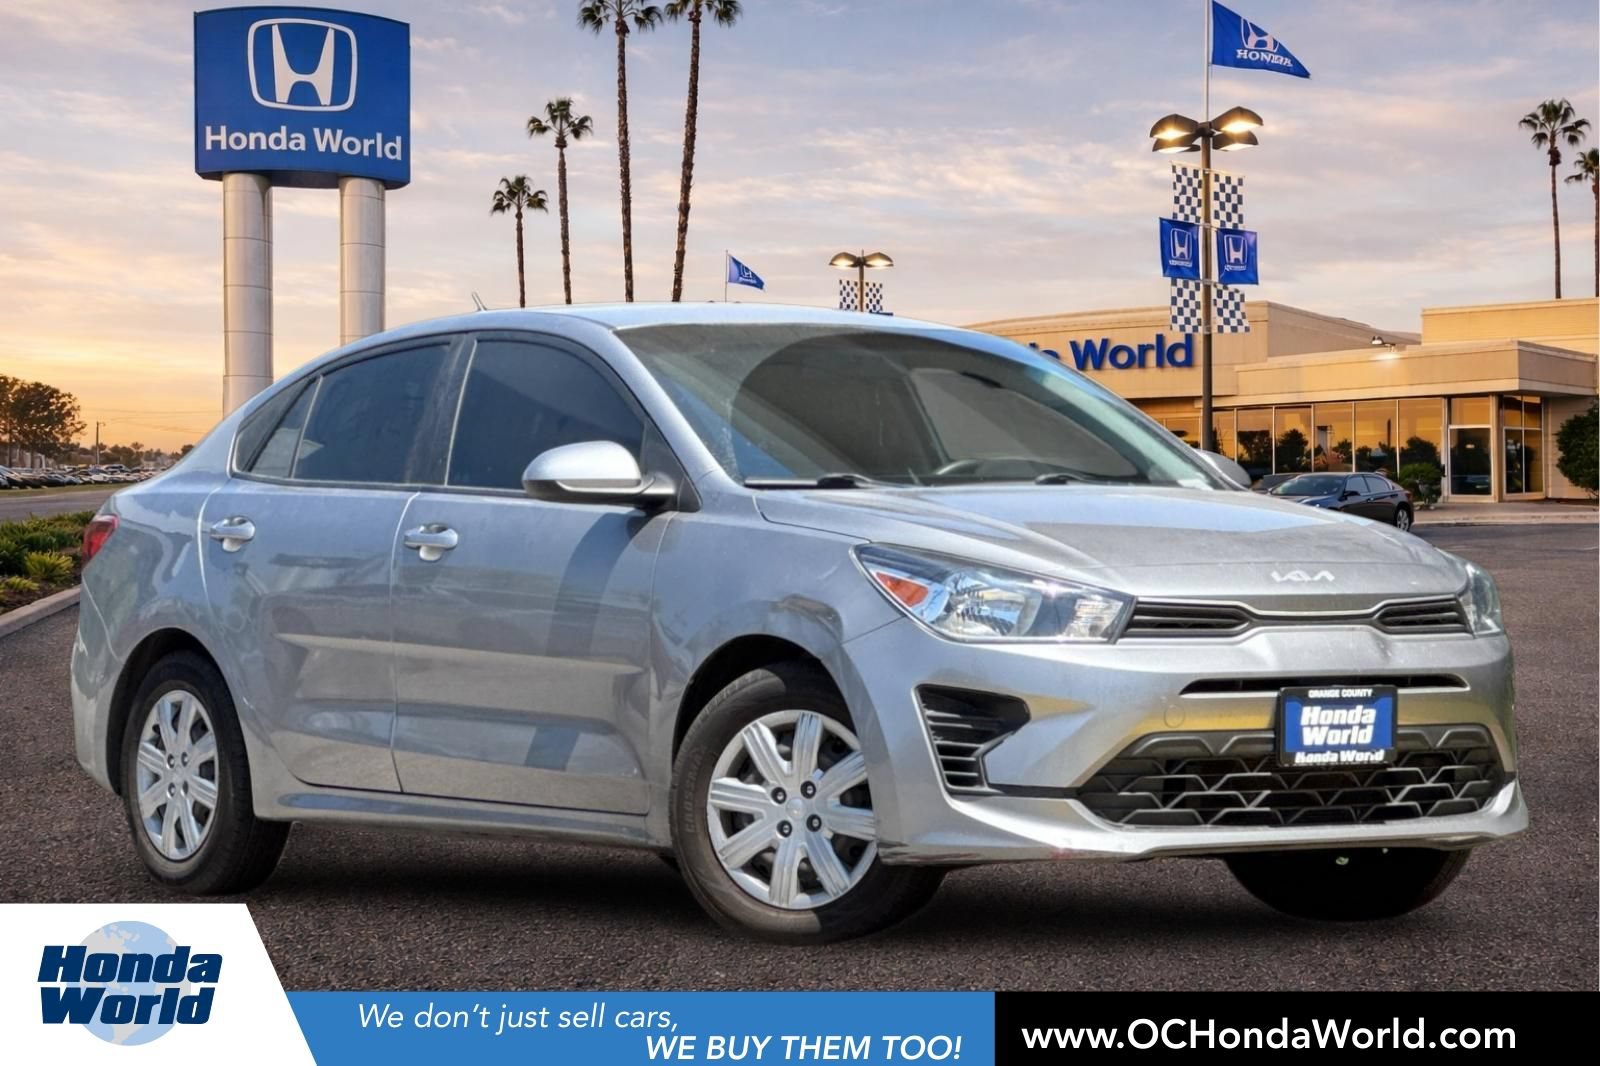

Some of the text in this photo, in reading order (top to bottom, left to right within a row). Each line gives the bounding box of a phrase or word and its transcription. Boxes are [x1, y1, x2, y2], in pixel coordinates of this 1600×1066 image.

[205, 125, 402, 160] Honda World
[1069, 333, 1194, 370] World
[1308, 688, 1373, 698] ORANGE COUNTY
[1301, 704, 1376, 726] Honda
[1302, 725, 1374, 746] World
